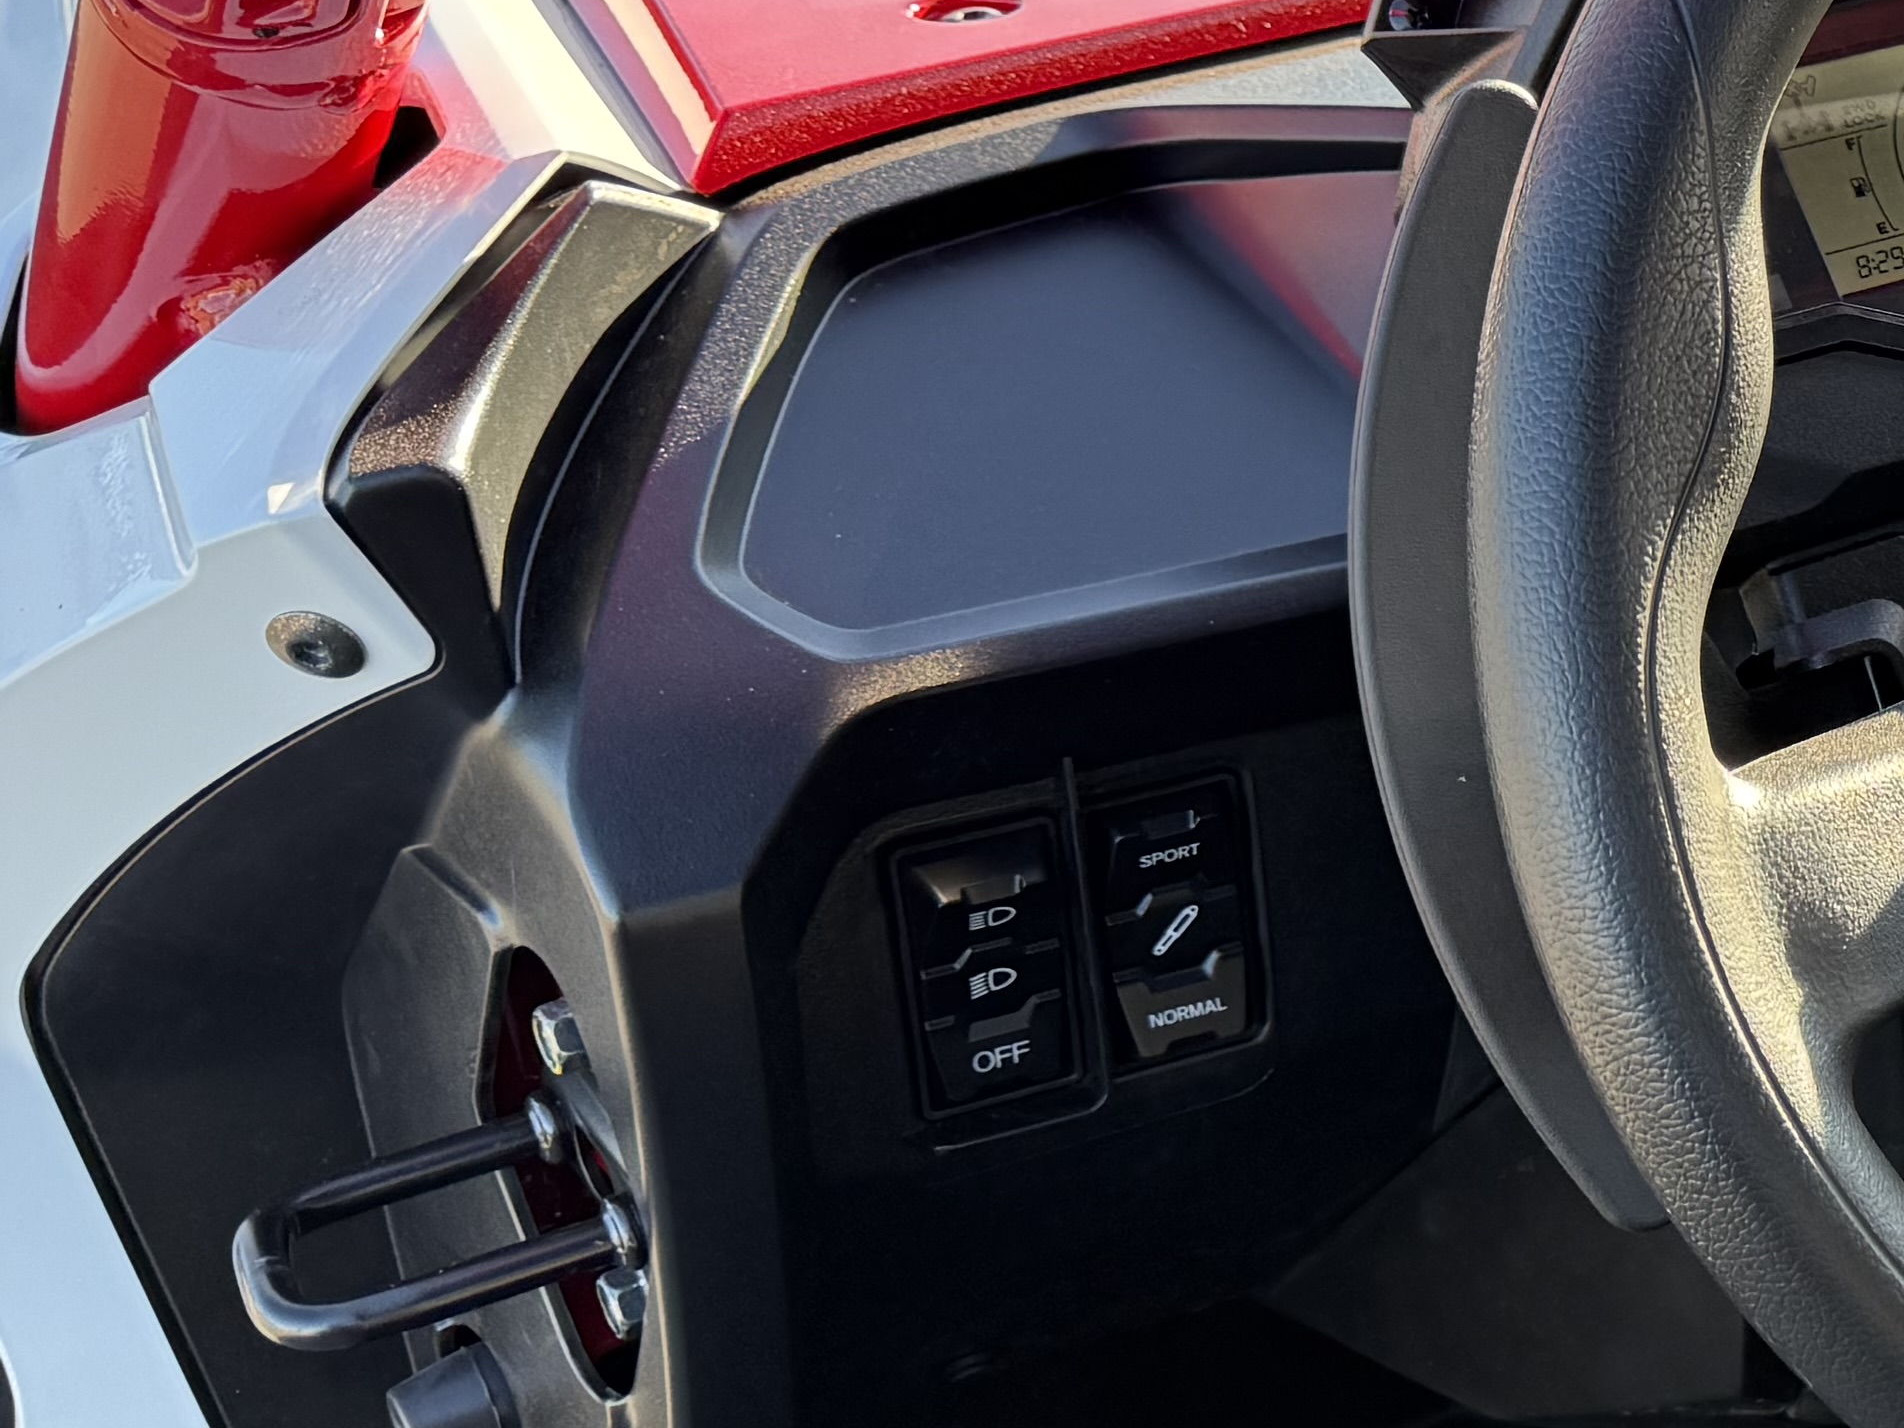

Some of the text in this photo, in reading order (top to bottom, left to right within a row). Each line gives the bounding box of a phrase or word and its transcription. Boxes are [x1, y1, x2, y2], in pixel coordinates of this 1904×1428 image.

[1845, 137, 1856, 151] F
[1876, 222, 1889, 235] E
[1138, 842, 1200, 868] SPORT
[1147, 997, 1228, 1029] NORMAL
[972, 1039, 1031, 1072] OFF
